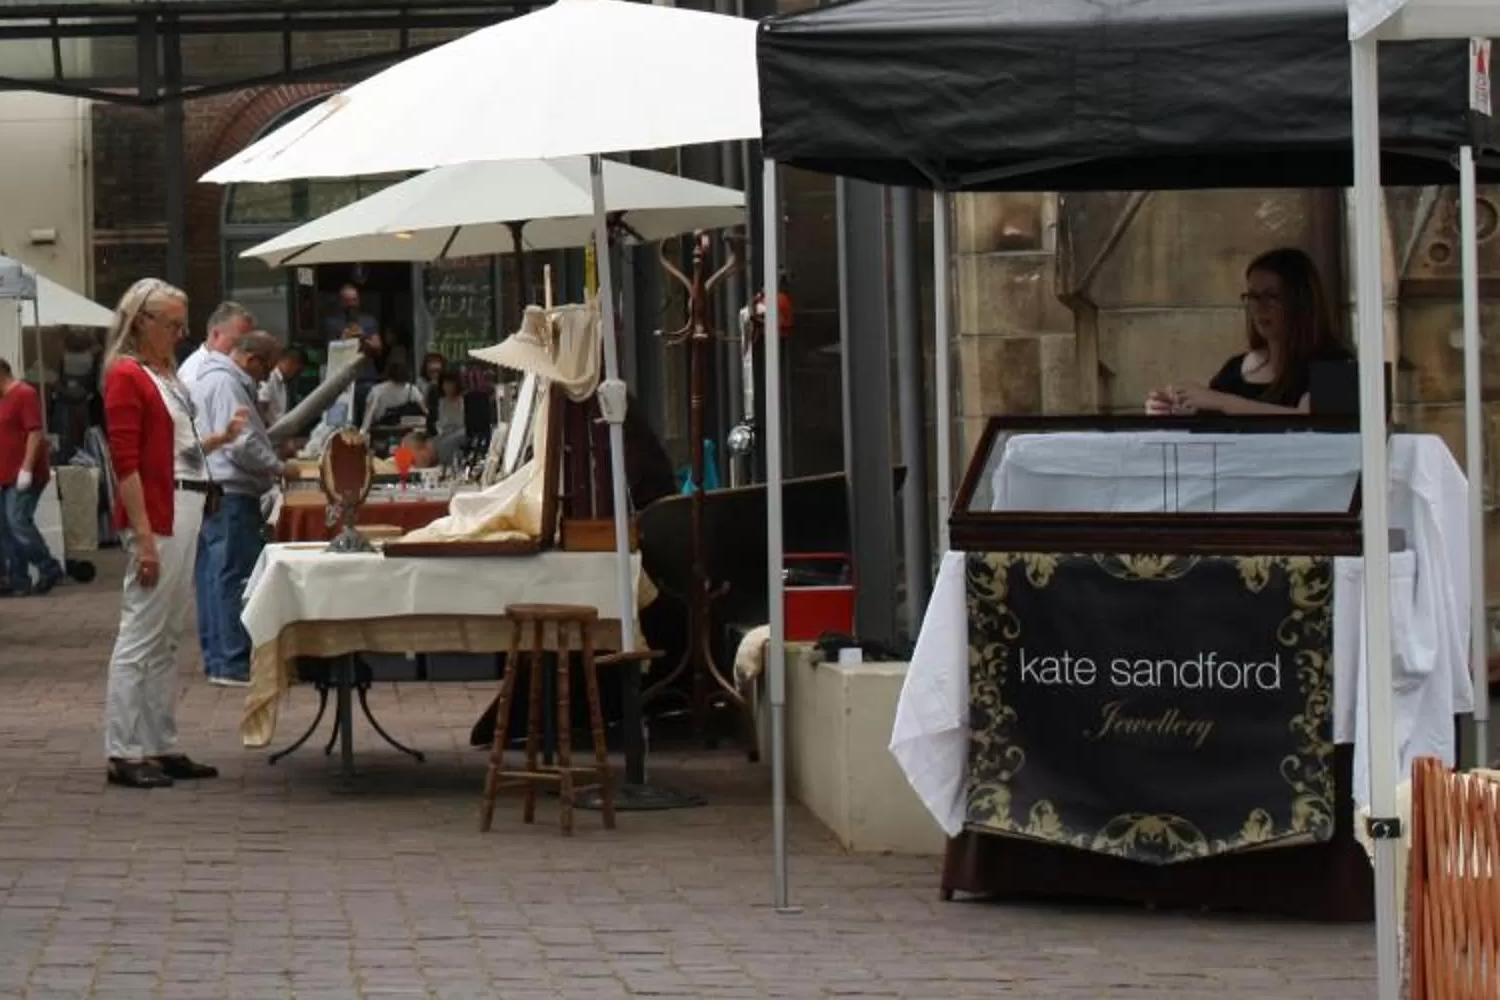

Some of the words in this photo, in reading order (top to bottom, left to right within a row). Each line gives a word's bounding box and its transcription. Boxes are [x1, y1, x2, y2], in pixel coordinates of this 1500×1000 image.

[1018, 647, 1098, 686] kate
[1110, 651, 1282, 690] sandford
[1082, 700, 1215, 748] Jewellery
